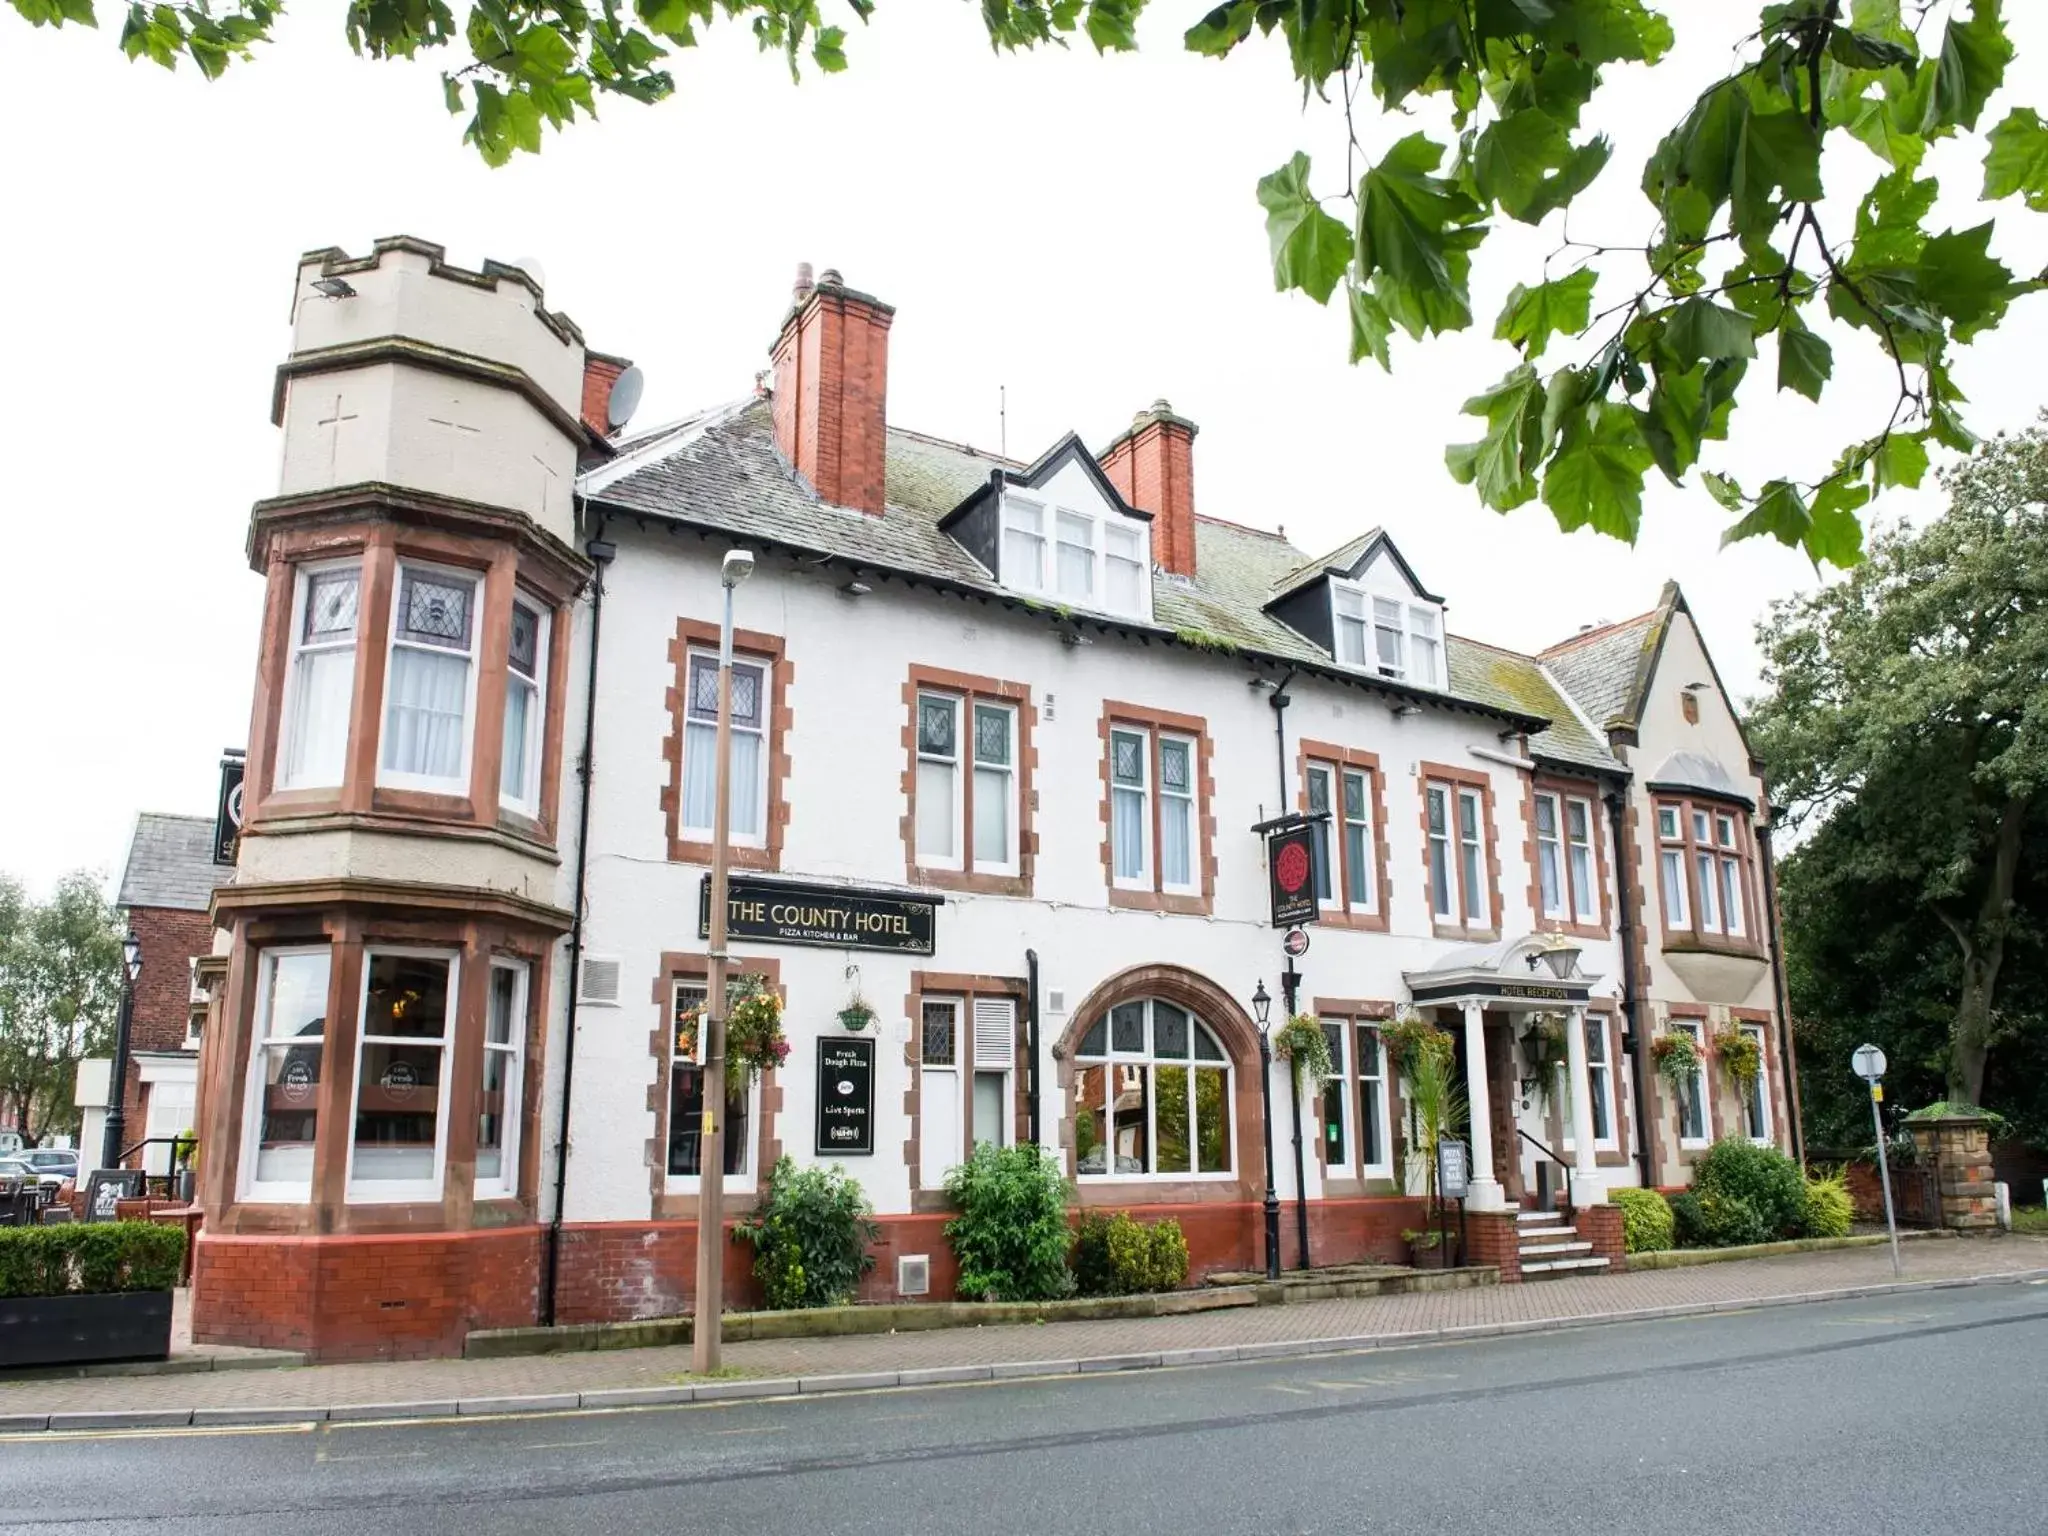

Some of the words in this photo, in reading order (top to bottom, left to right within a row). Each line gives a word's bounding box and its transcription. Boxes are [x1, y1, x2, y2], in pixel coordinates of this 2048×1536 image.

[727, 900, 766, 922] THE
[771, 904, 851, 929] COUNTY
[855, 911, 912, 935] HOTEL
[779, 927, 801, 937] PIZZA
[802, 929, 835, 940] KITCHEN
[843, 932, 858, 941] BAR
[1501, 985, 1525, 996] HOTEL
[1527, 986, 1568, 999] RECEPTION
[825, 1058, 849, 1068] Dough
[825, 1104, 842, 1114] Live
